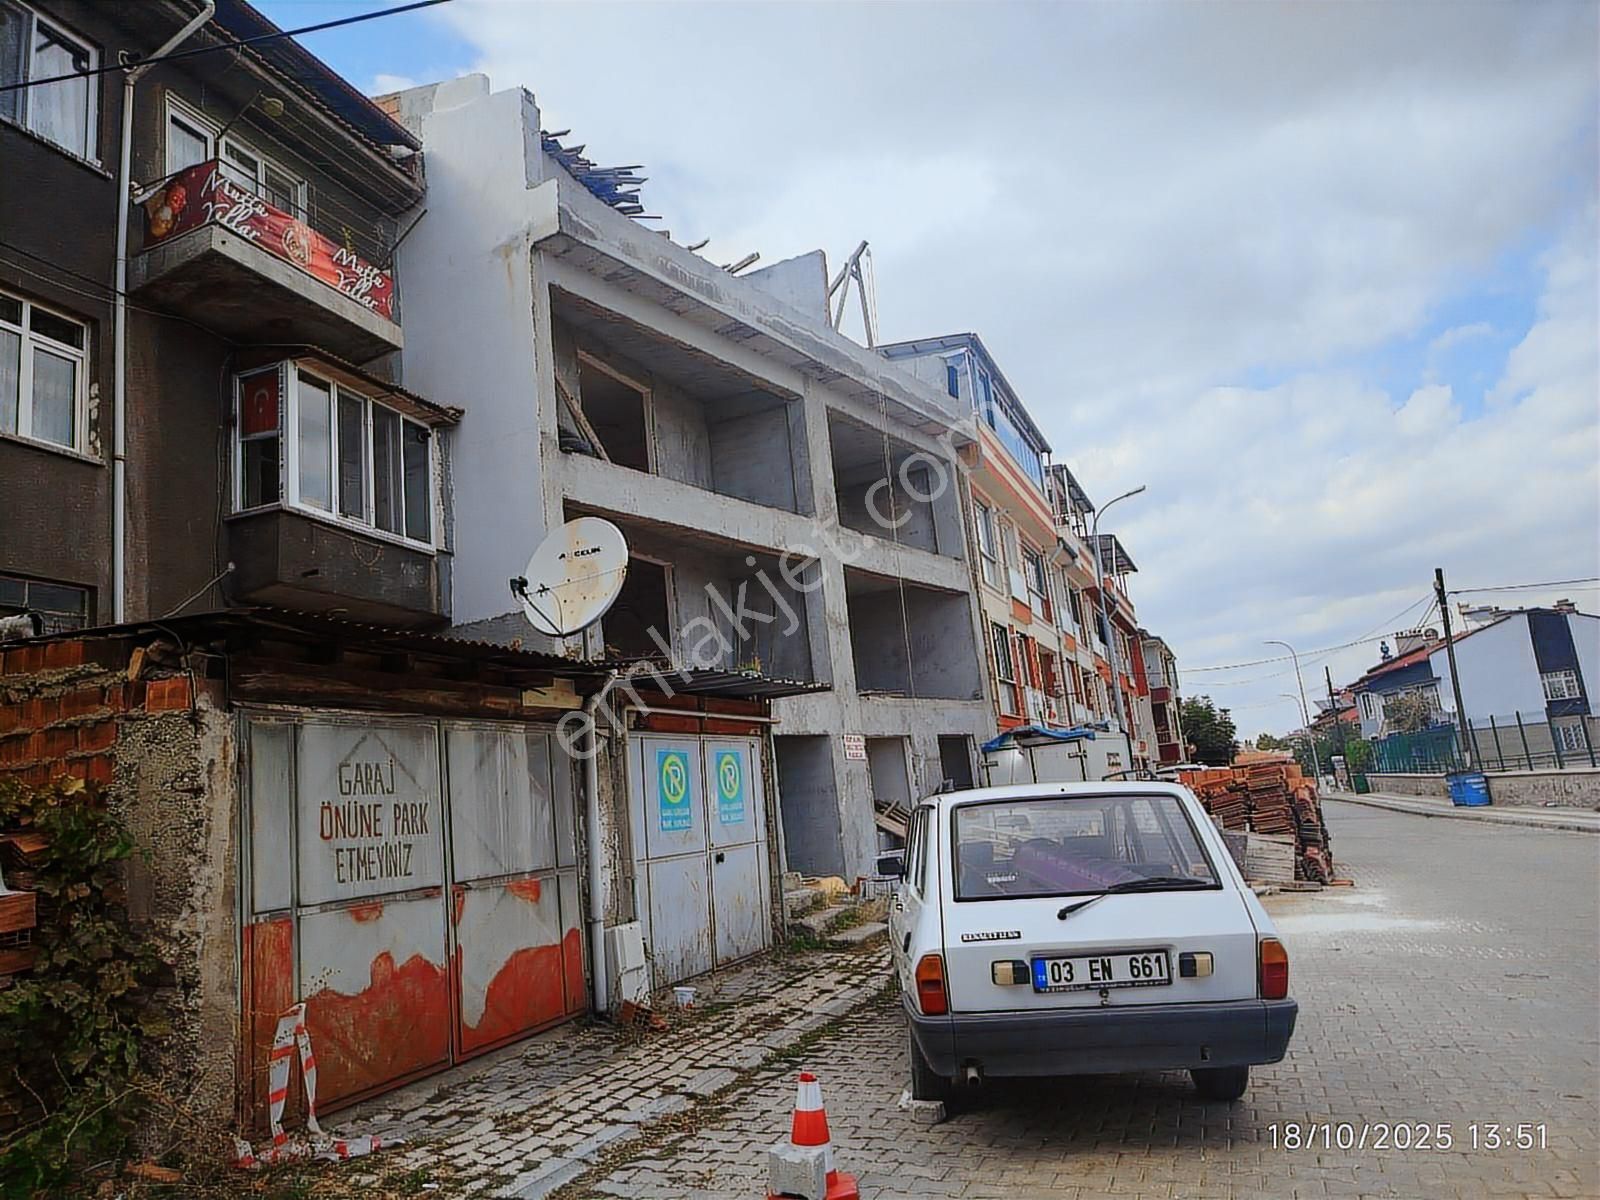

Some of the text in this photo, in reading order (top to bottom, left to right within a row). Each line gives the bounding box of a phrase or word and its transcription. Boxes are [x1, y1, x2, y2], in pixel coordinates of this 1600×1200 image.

[338, 759, 395, 796] GARAJ
[320, 801, 429, 840] ÖNÜNE PARK
[1050, 961, 1074, 983] 03
[1088, 958, 1113, 981] EN
[1129, 955, 1164, 978] 661
